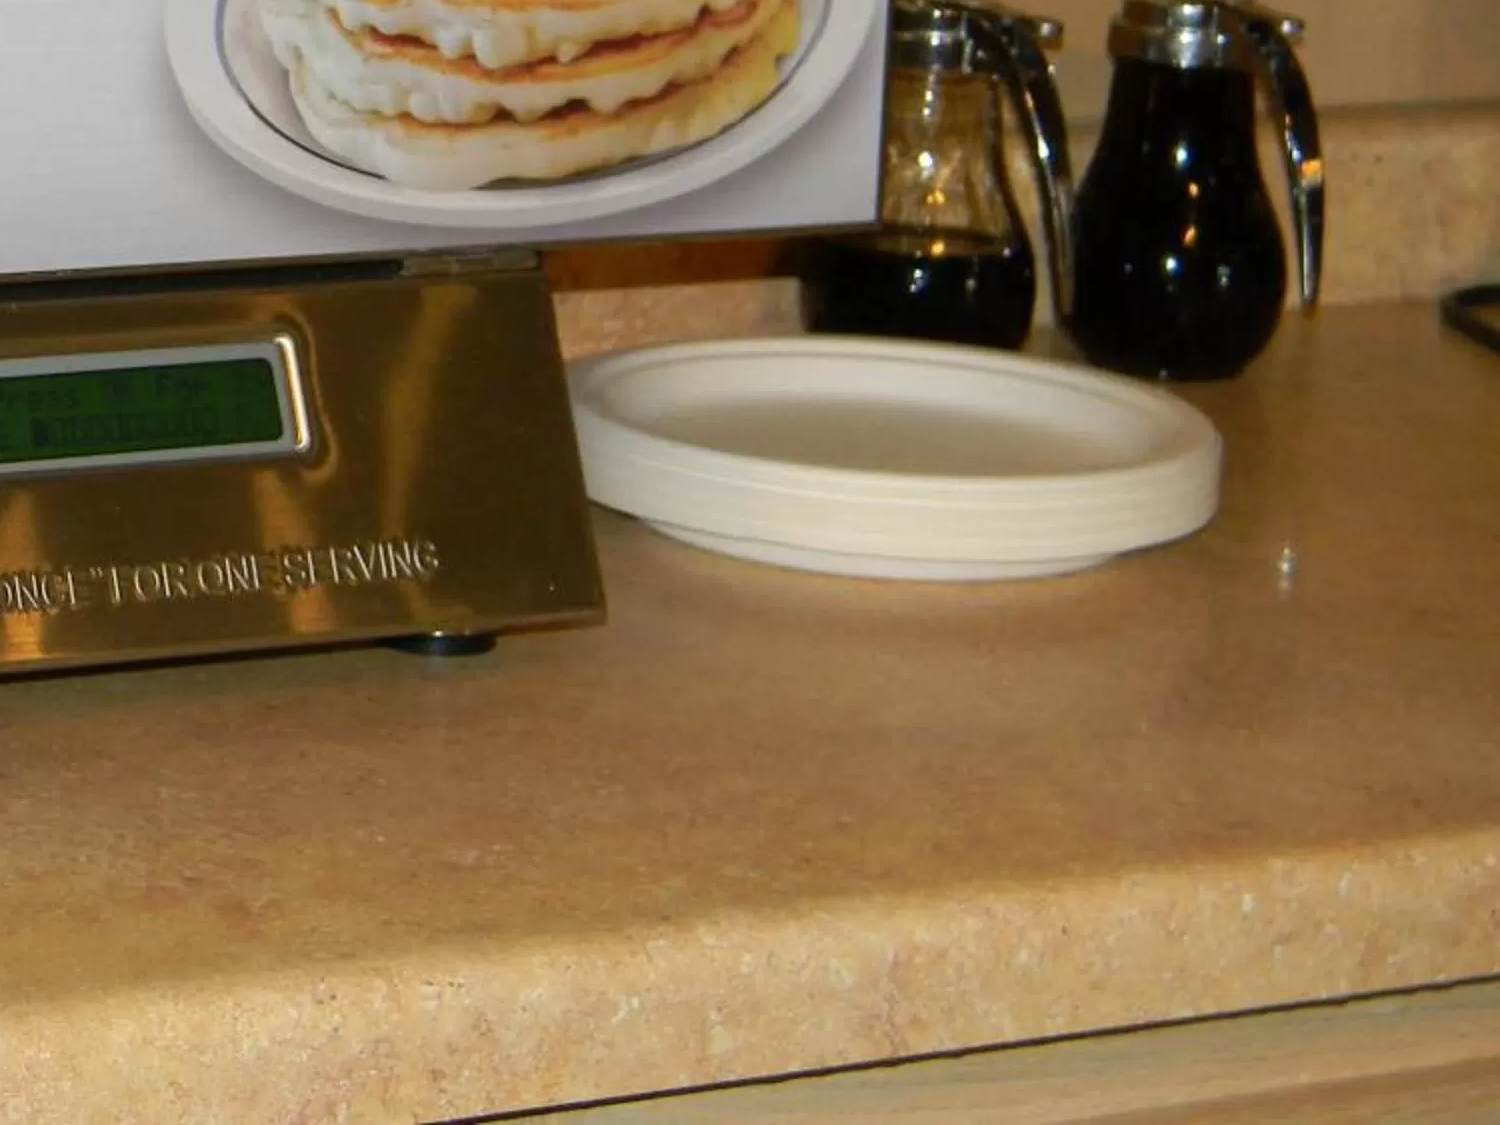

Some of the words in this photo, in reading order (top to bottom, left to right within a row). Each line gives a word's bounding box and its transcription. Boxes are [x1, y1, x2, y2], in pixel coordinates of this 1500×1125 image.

[111, 559, 191, 607] FOR
[197, 553, 279, 597] ONE
[282, 539, 440, 591] SERVING
